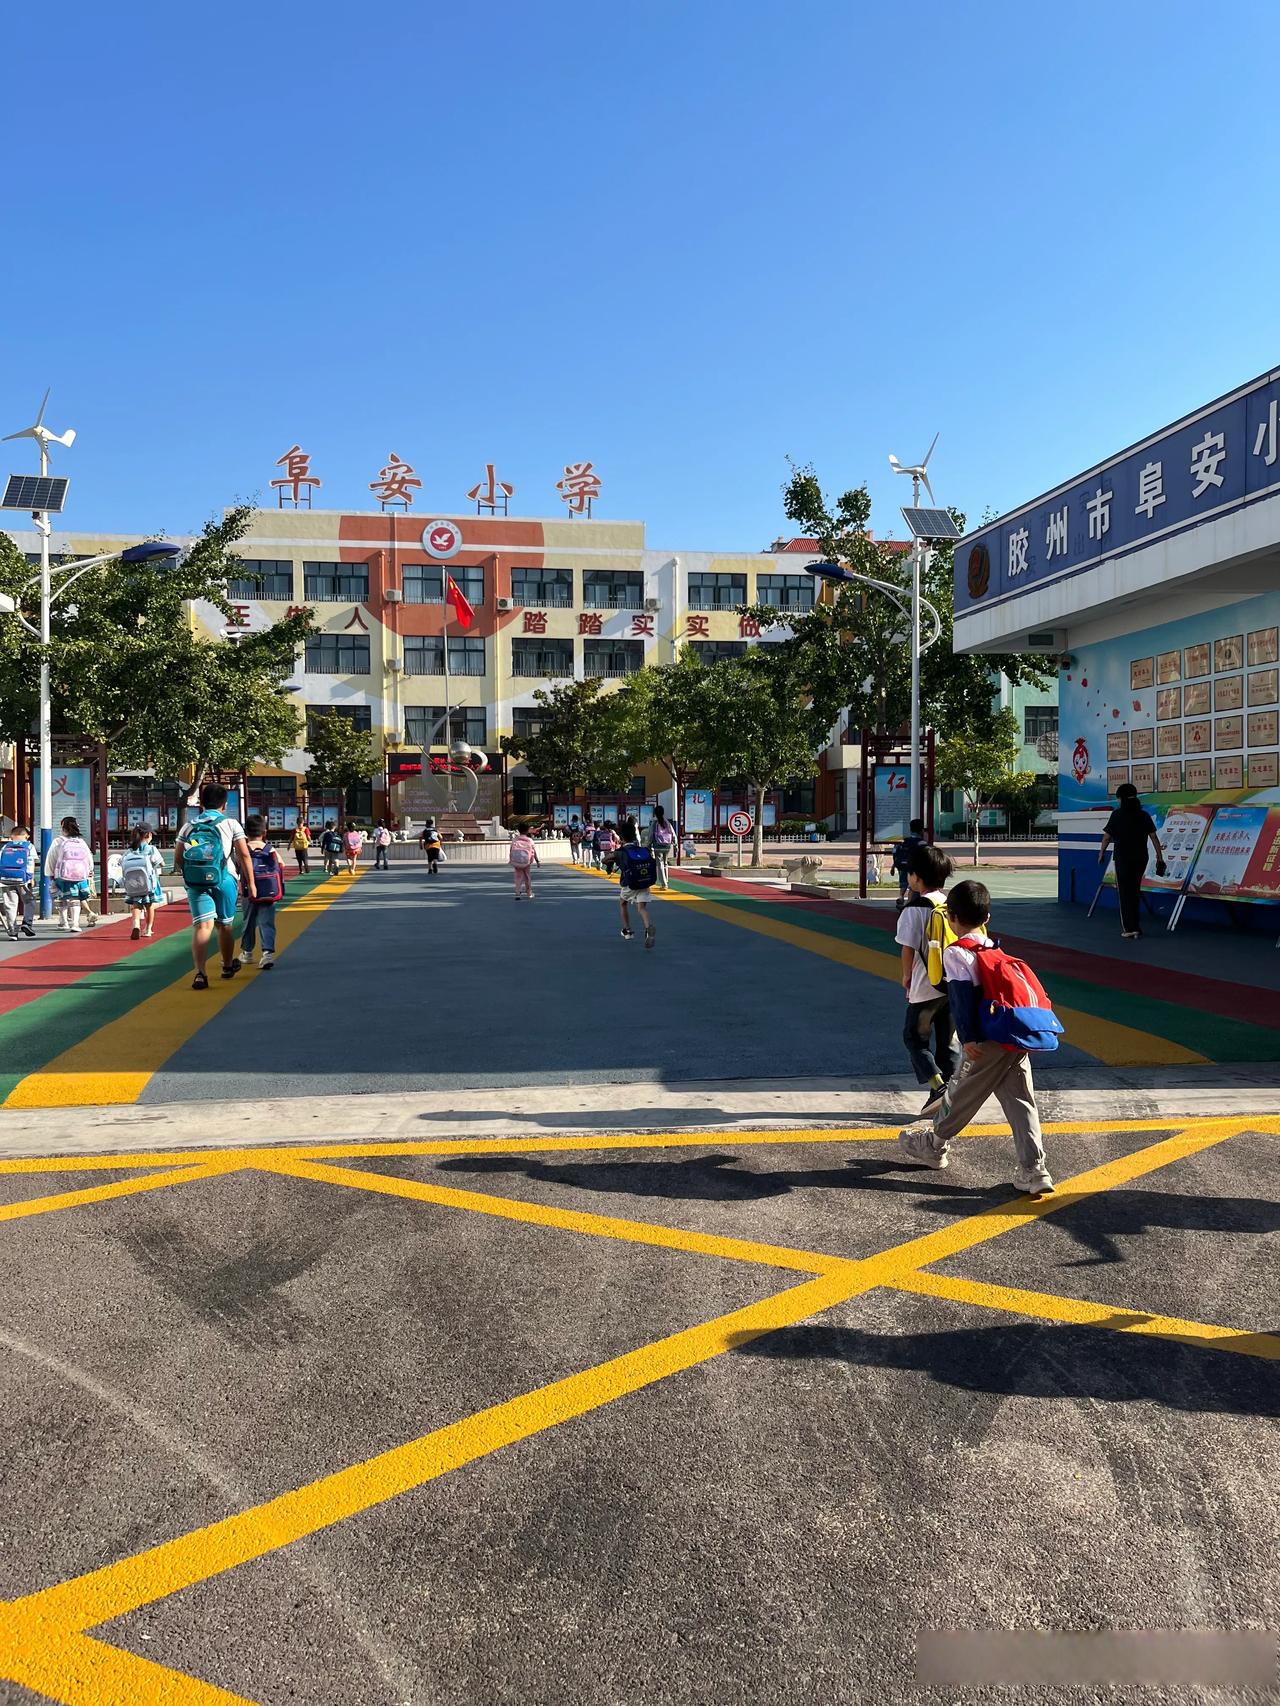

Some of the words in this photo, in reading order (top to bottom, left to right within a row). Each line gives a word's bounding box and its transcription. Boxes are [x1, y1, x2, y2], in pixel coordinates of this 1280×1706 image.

[269, 444, 603, 514] 阜安小学
[734, 816, 742, 827] 5
